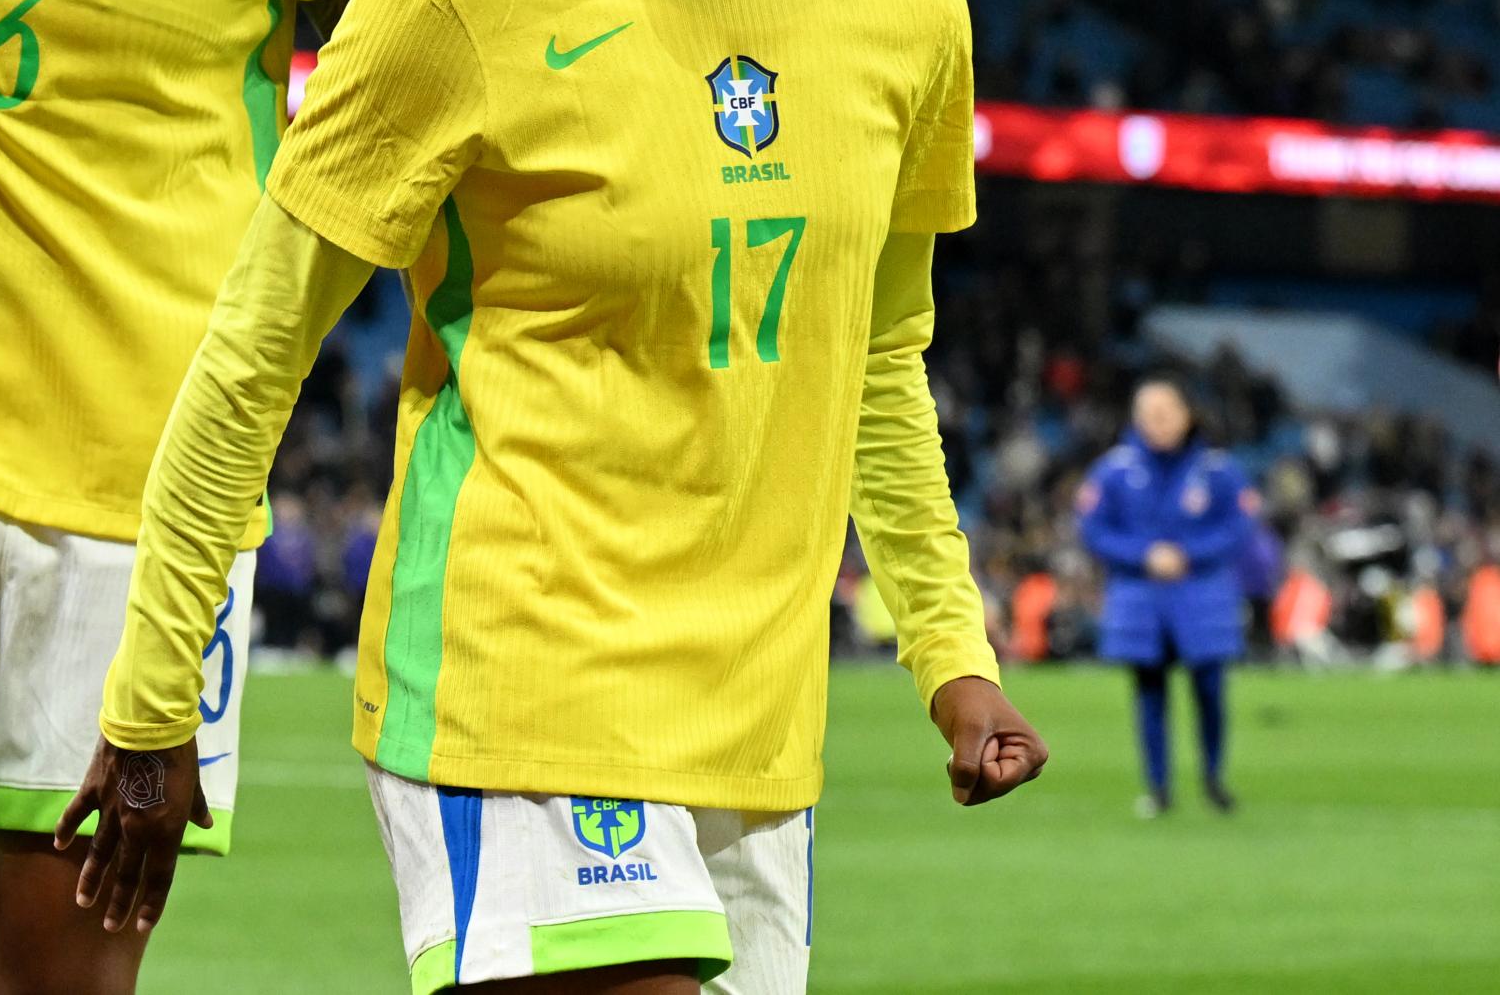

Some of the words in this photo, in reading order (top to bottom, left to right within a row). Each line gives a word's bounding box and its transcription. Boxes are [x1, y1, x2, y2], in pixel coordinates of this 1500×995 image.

[729, 96, 756, 109] CBF
[721, 162, 791, 184] BRASIL
[708, 216, 806, 369] 17
[592, 799, 622, 811] CBF
[577, 862, 658, 886] BRASIL
